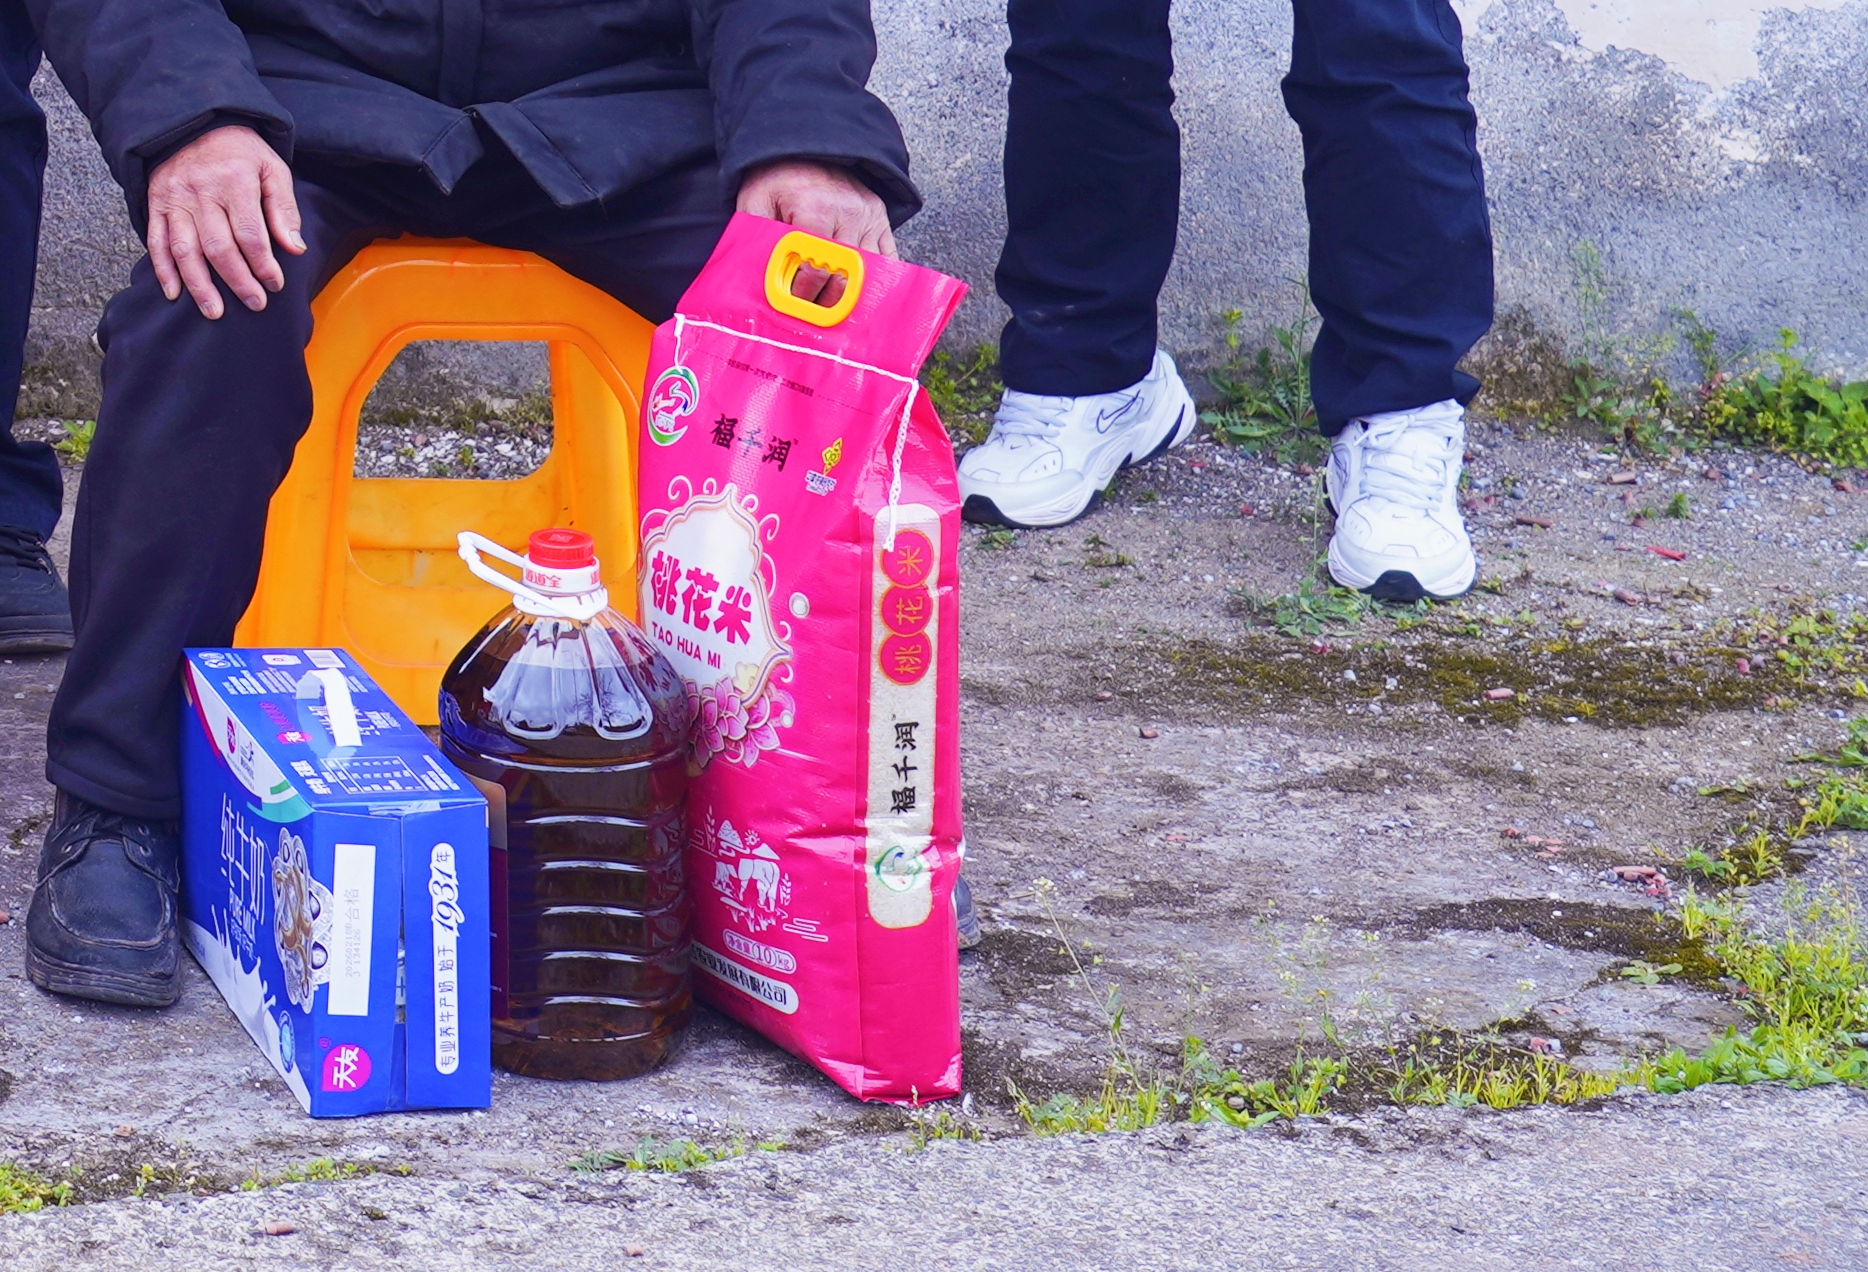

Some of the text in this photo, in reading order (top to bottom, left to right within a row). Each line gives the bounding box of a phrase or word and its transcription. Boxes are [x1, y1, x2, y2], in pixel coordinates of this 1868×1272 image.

[651, 549, 752, 646] 桃花米
[895, 546, 924, 676] 桃花米
[652, 621, 721, 670] TAO HUA MI
[890, 720, 920, 815] 福千润
[344, 887, 360, 922] 合格
[437, 944, 455, 972] 始于
[438, 980, 456, 1068] 专业养牛产奶
